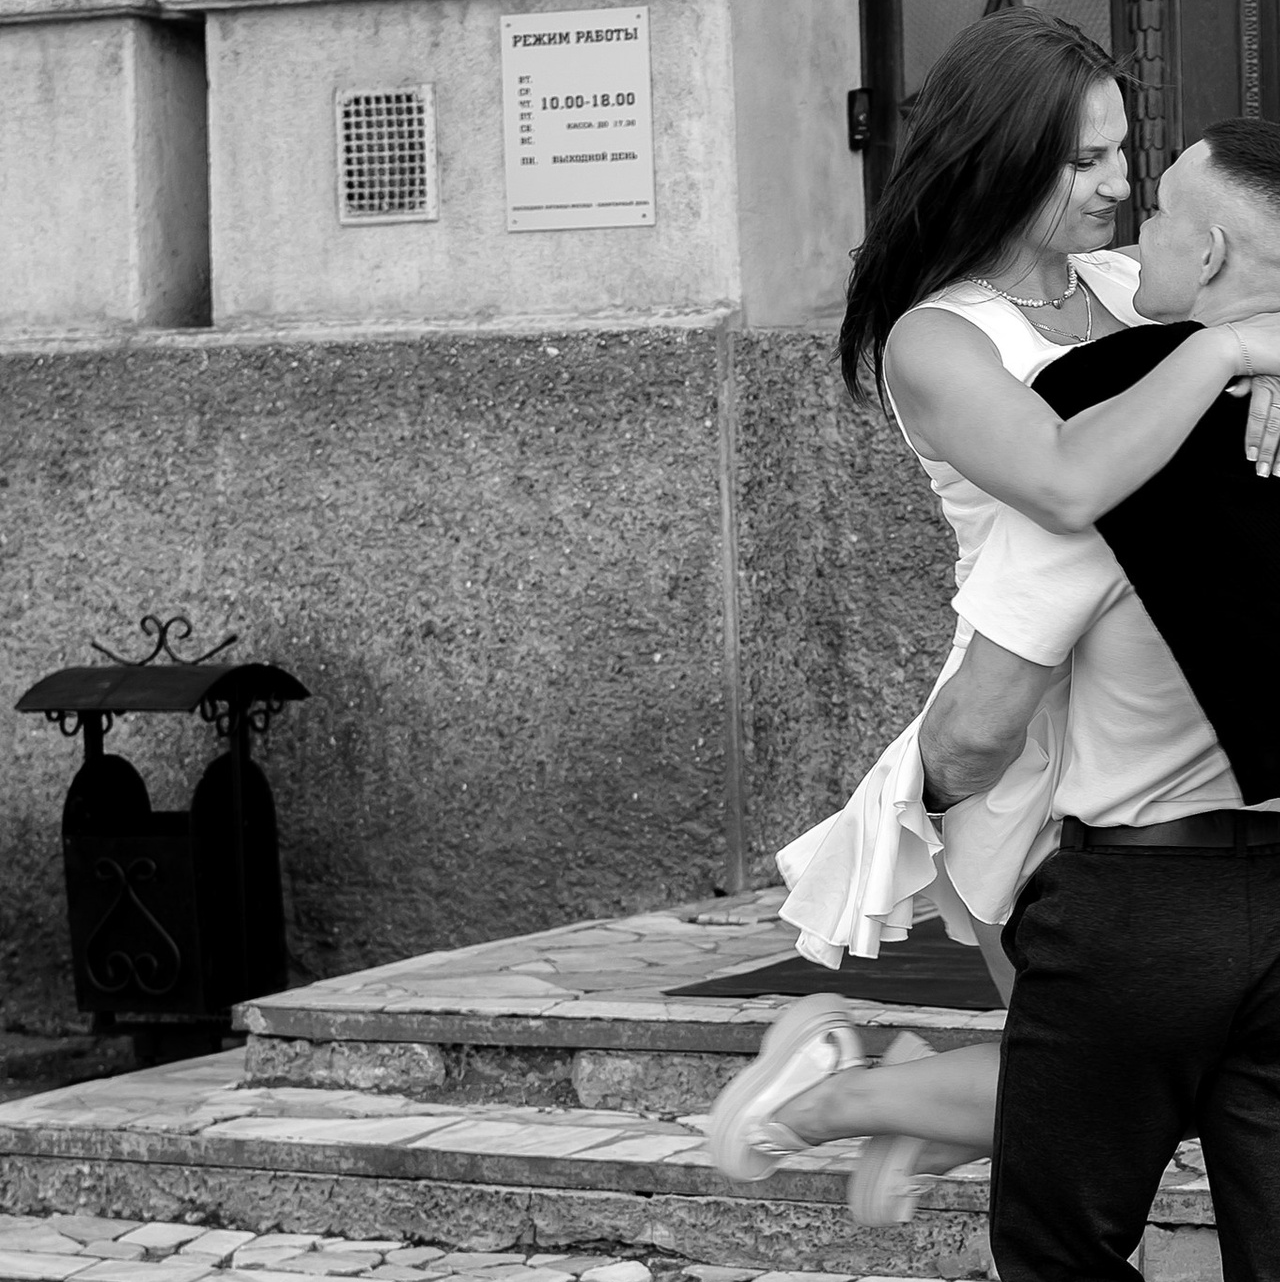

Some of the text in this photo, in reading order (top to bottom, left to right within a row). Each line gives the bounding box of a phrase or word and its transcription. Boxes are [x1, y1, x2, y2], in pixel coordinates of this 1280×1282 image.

[512, 27, 639, 48] РЕЖИМ РАБОТЫ
[541, 92, 636, 111] 10.00-18.00
[551, 150, 608, 165] ВЫХОДНОЙ
[610, 150, 638, 162] ДЕНЬ
